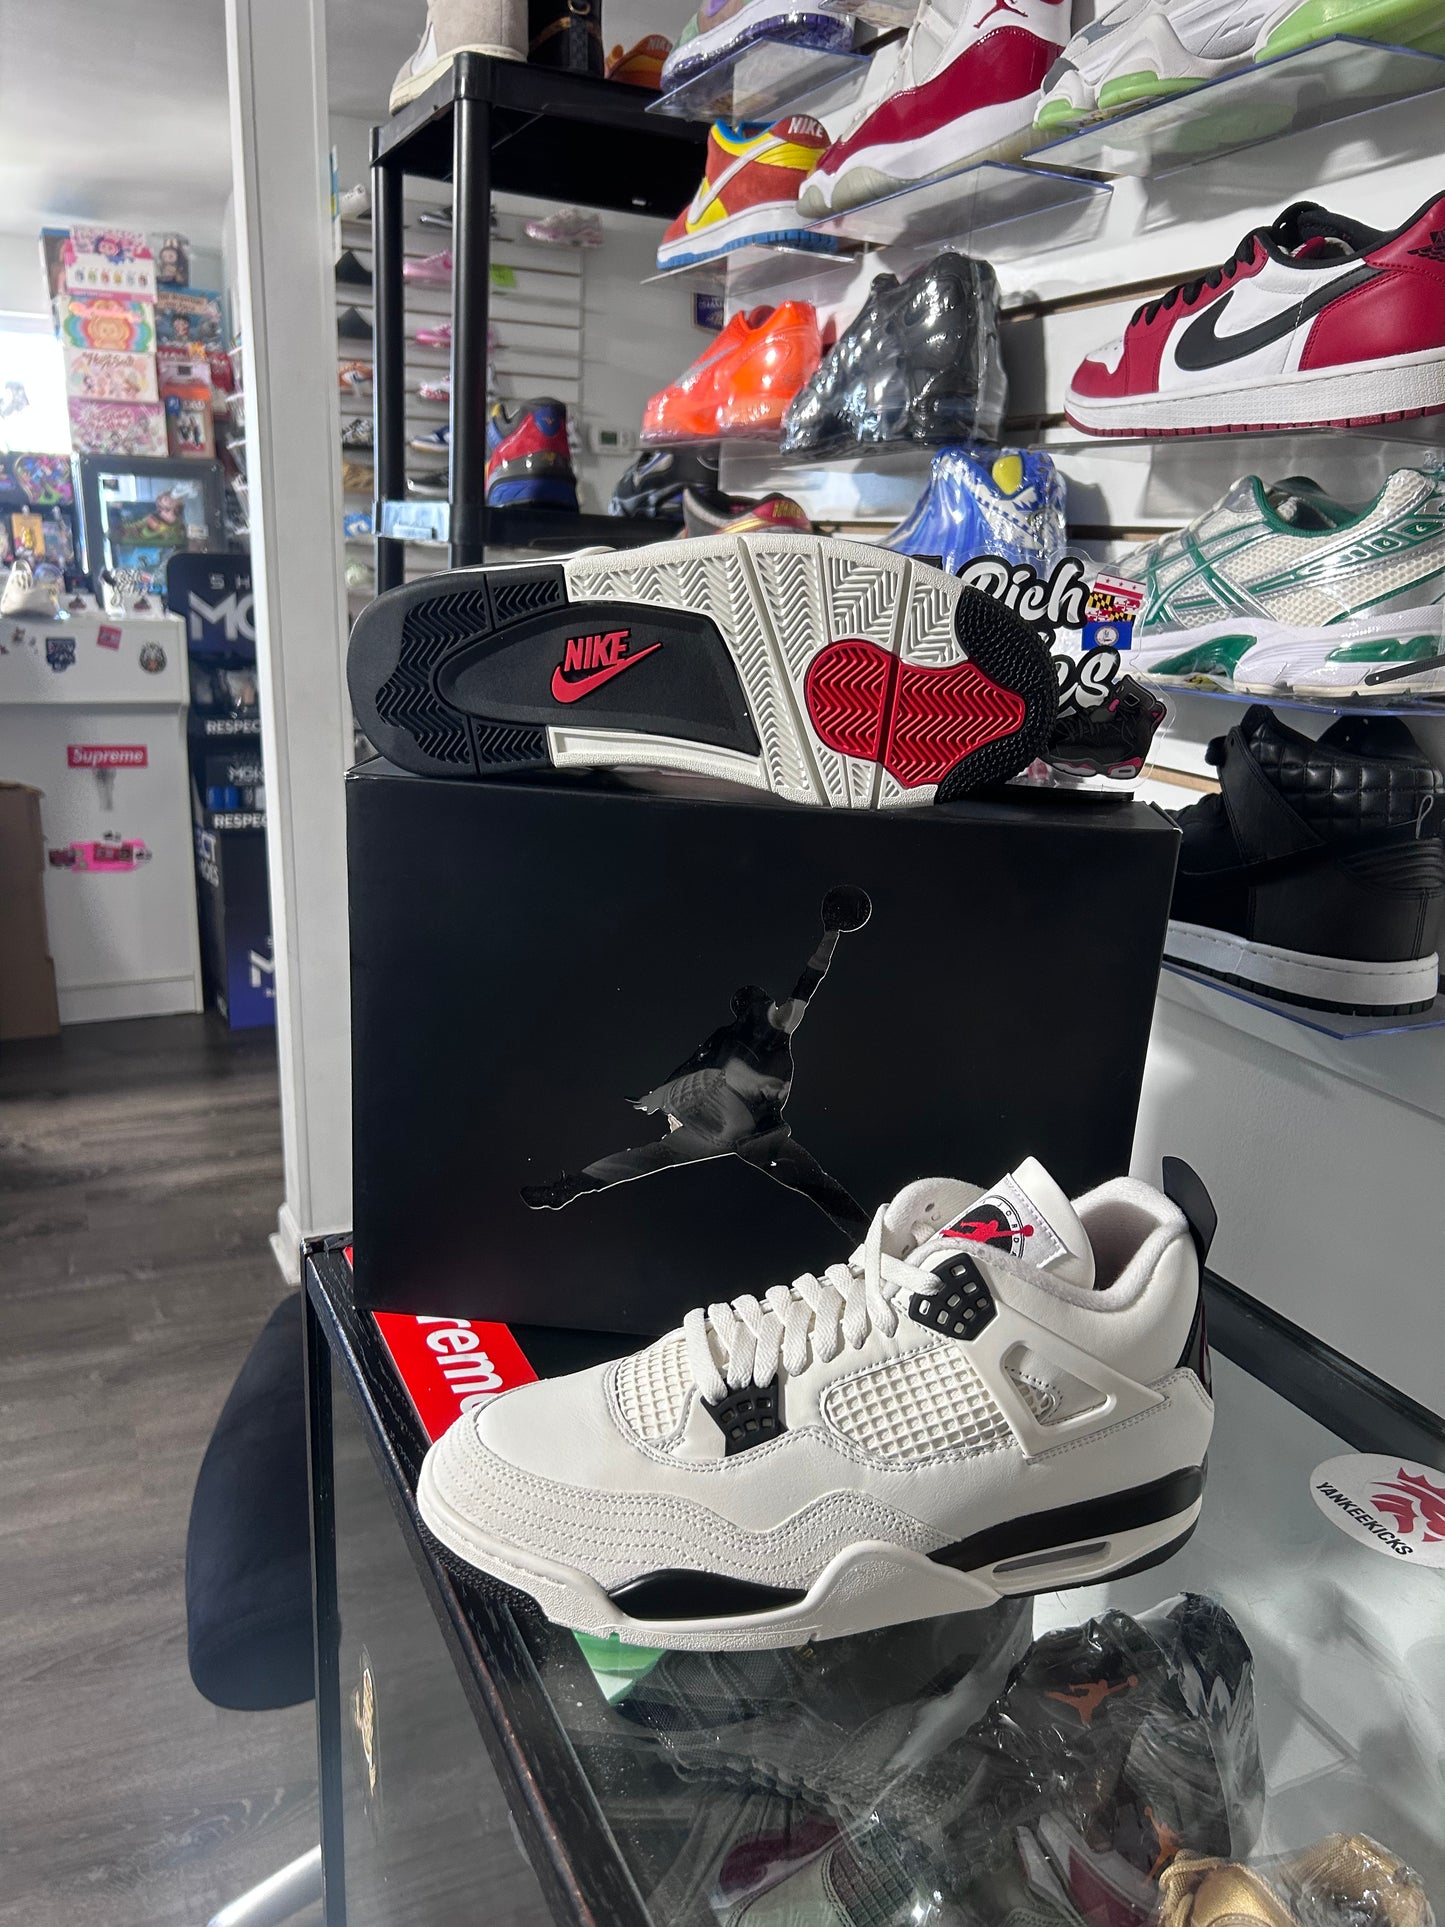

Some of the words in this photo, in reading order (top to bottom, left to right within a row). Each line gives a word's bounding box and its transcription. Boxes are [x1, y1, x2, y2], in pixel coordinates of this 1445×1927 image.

[787, 116, 824, 138] NIKE
[564, 630, 629, 672] NIKE
[73, 748, 144, 767] Supreme
[1315, 1481, 1414, 1556] YANKEEKICKS
